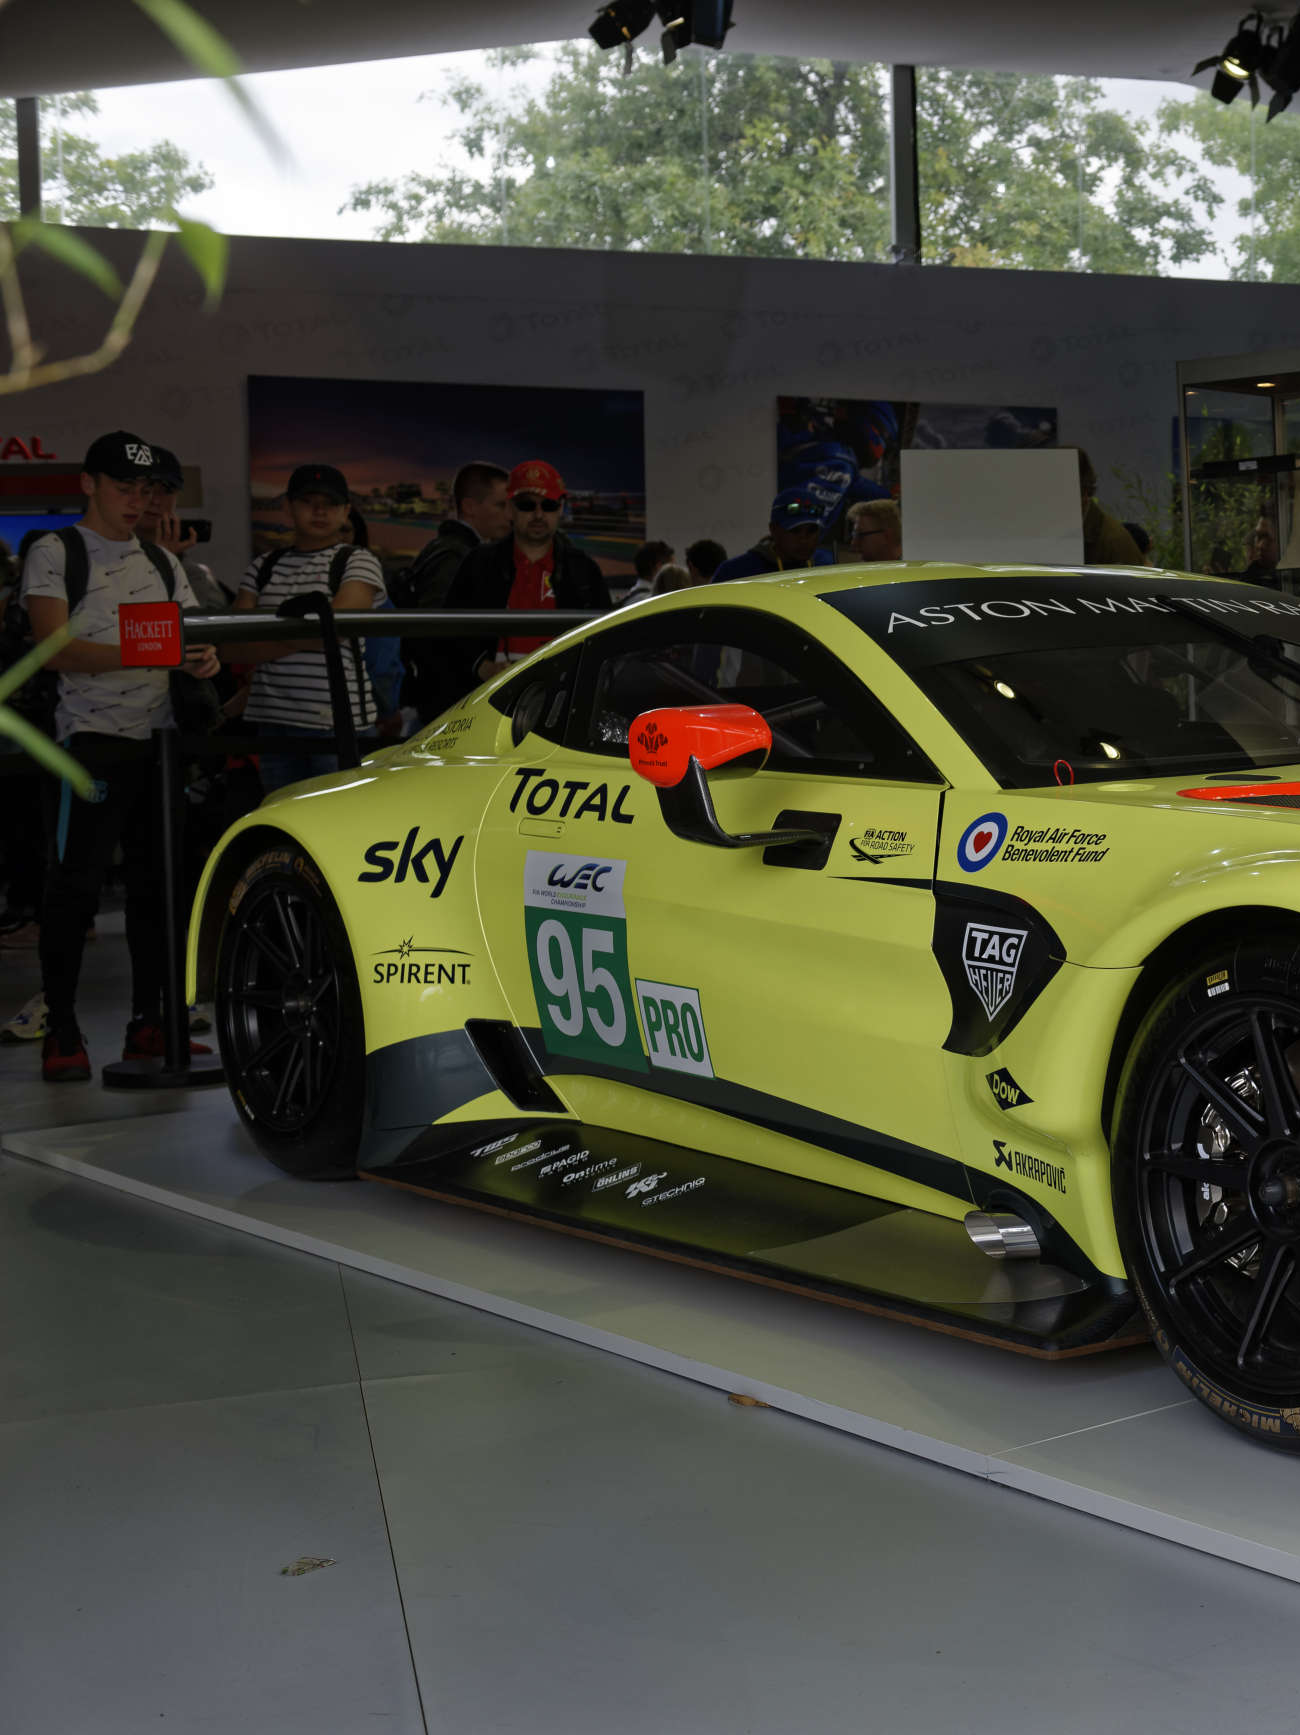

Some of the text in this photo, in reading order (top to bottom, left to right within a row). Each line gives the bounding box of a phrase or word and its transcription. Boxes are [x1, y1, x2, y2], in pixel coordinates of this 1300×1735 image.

[0, 436, 57, 460] AL
[124, 619, 174, 640] HACKETT
[886, 597, 1071, 634] ASTON
[509, 768, 635, 824] TOTAL
[870, 841, 889, 850] ROAD
[888, 842, 916, 853] SAFETY
[875, 830, 907, 842] ACTION
[1010, 826, 1107, 846] Royal Air Force
[358, 826, 464, 898] sky
[1001, 844, 1110, 863] Benevolent Fund
[548, 862, 612, 893] WEC
[971, 931, 1019, 964] TAG
[536, 919, 627, 1047] 95
[969, 967, 1012, 1014] HEUER
[646, 995, 704, 1063] PRO
[993, 1073, 1020, 1105] DOW
